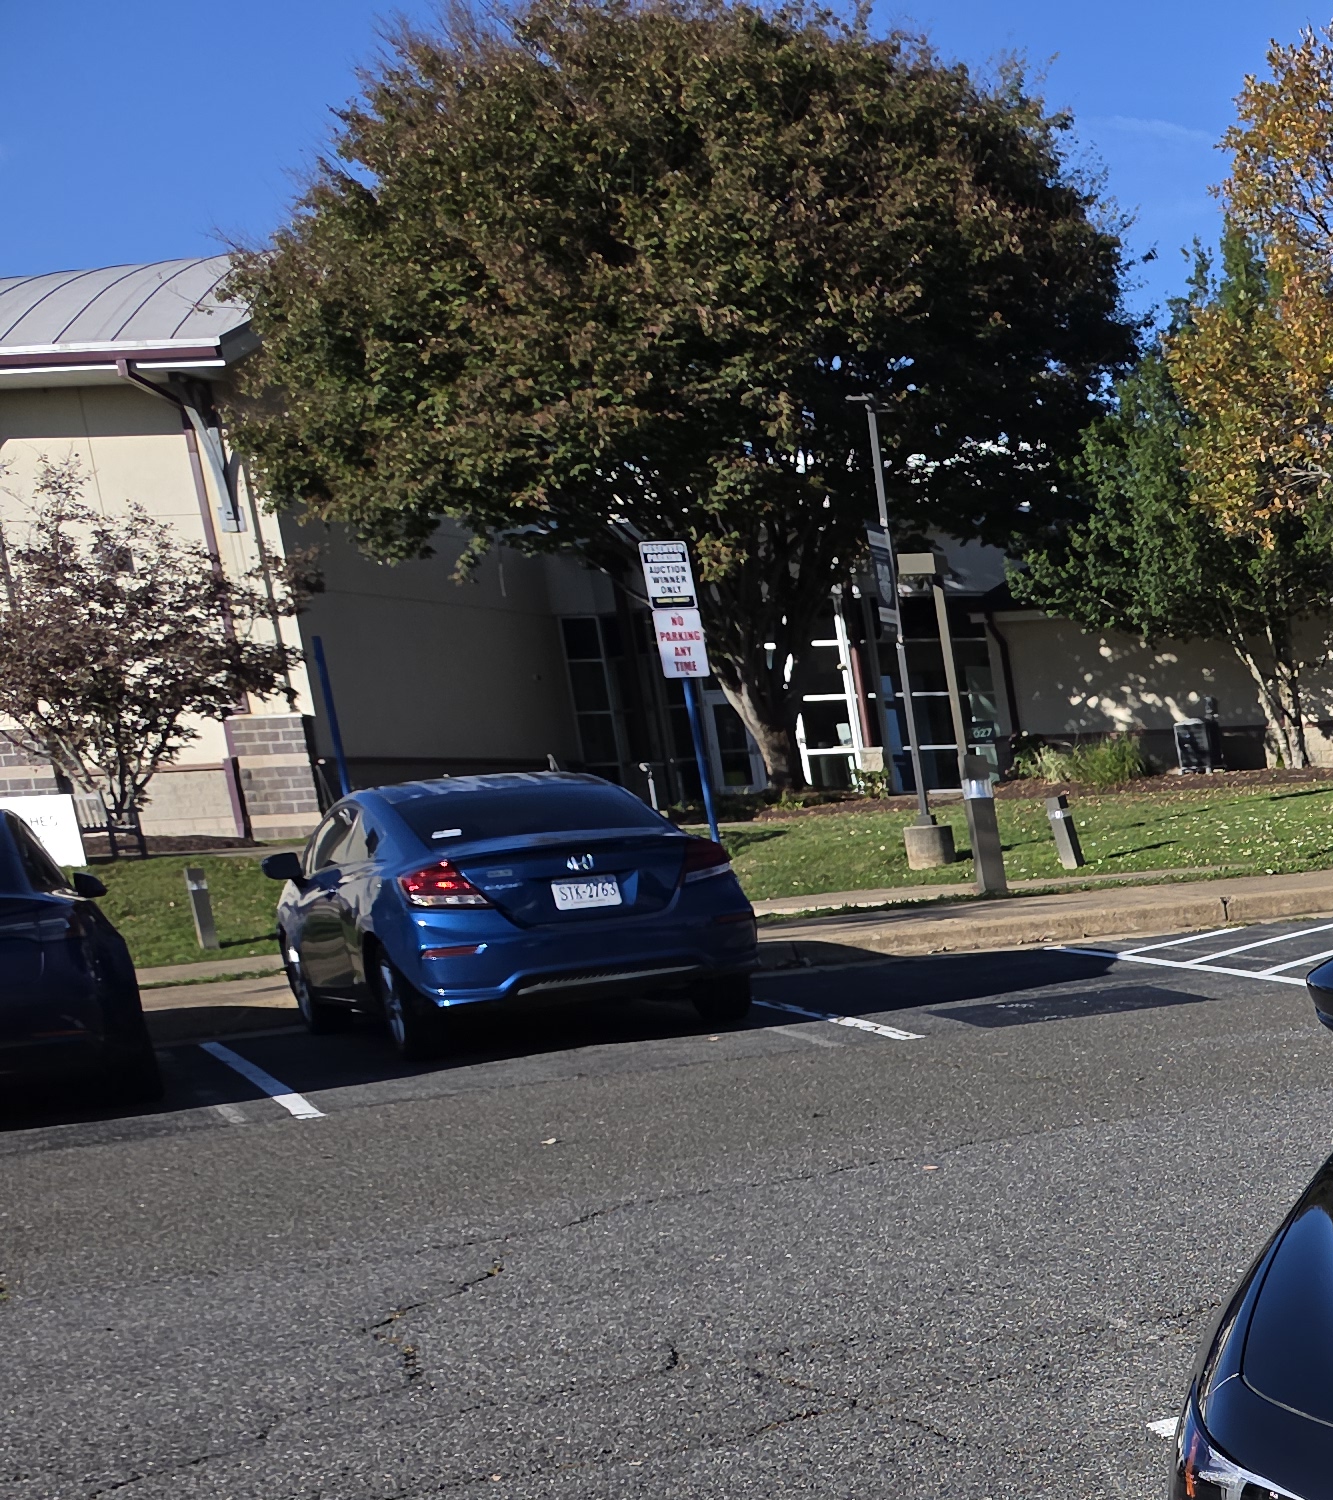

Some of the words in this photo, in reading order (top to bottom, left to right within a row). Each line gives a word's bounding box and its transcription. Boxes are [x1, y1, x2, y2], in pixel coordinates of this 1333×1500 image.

[649, 565, 687, 574] AUCTION
[651, 575, 688, 584] WINNER
[660, 586, 682, 594] ONLY
[670, 616, 684, 627] NO
[659, 631, 701, 642] PARKING
[674, 646, 692, 657] ANY
[674, 660, 698, 672] TIME
[558, 882, 617, 901] STK-2763
